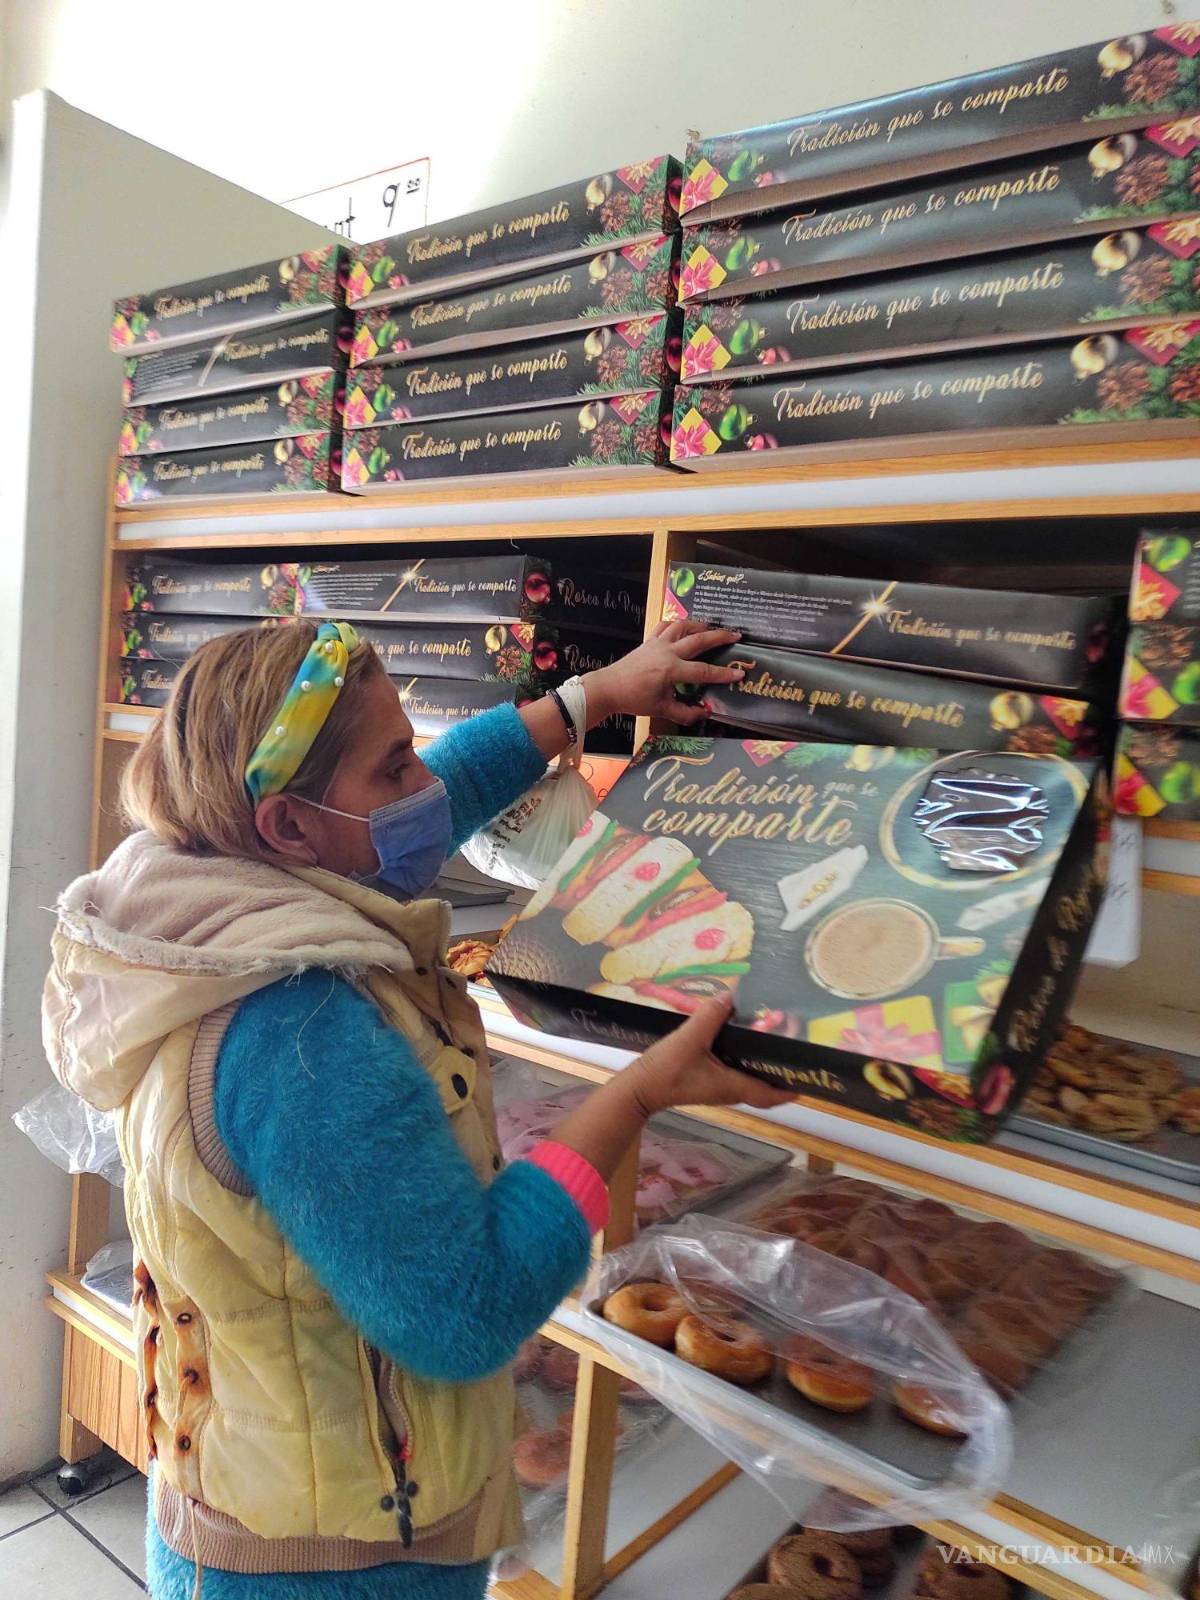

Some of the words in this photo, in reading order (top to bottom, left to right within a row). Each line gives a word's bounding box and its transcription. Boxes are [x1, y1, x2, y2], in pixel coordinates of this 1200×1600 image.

[786, 119, 881, 158] Tradición
[887, 109, 925, 144] que
[930, 98, 954, 120] se
[961, 66, 1070, 115] comparte
[406, 233, 464, 265] Tradición
[465, 230, 489, 258] que
[491, 222, 507, 240] se
[508, 201, 569, 239] comparte
[781, 207, 875, 246] Tradición
[880, 202, 918, 235] que
[923, 192, 946, 214] se
[953, 164, 1061, 212] comparte
[410, 299, 466, 330] Tradición
[465, 298, 491, 323] que
[493, 293, 507, 308] se
[510, 273, 574, 307] comparte
[786, 293, 880, 335] Tradición
[885, 293, 923, 329] que
[928, 285, 952, 309] se
[959, 261, 1066, 309] comparte
[406, 365, 464, 398] Tradición
[464, 369, 488, 396] que
[490, 363, 505, 382] se
[507, 348, 569, 384] comparte
[772, 380, 864, 422] Tradición
[868, 385, 905, 420] que
[911, 379, 934, 401] se
[940, 361, 1046, 404] comparte
[402, 430, 458, 462] Tradición
[458, 438, 483, 463] que
[484, 432, 500, 449] se
[501, 419, 563, 454] comparte
[414, 574, 450, 593] Tradición
[451, 581, 467, 598] que
[467, 579, 478, 593] se
[478, 577, 518, 597] comparte
[617, 590, 643, 626] Rey
[387, 642, 406, 663] que
[407, 640, 420, 656] se
[421, 637, 473, 663] comparte
[808, 688, 842, 716] que
[844, 688, 866, 710] se
[869, 694, 966, 729] comparte
[643, 751, 820, 806] Tradición
[821, 781, 858, 800] que
[859, 782, 880, 797] se
[641, 794, 860, 858] comparte
